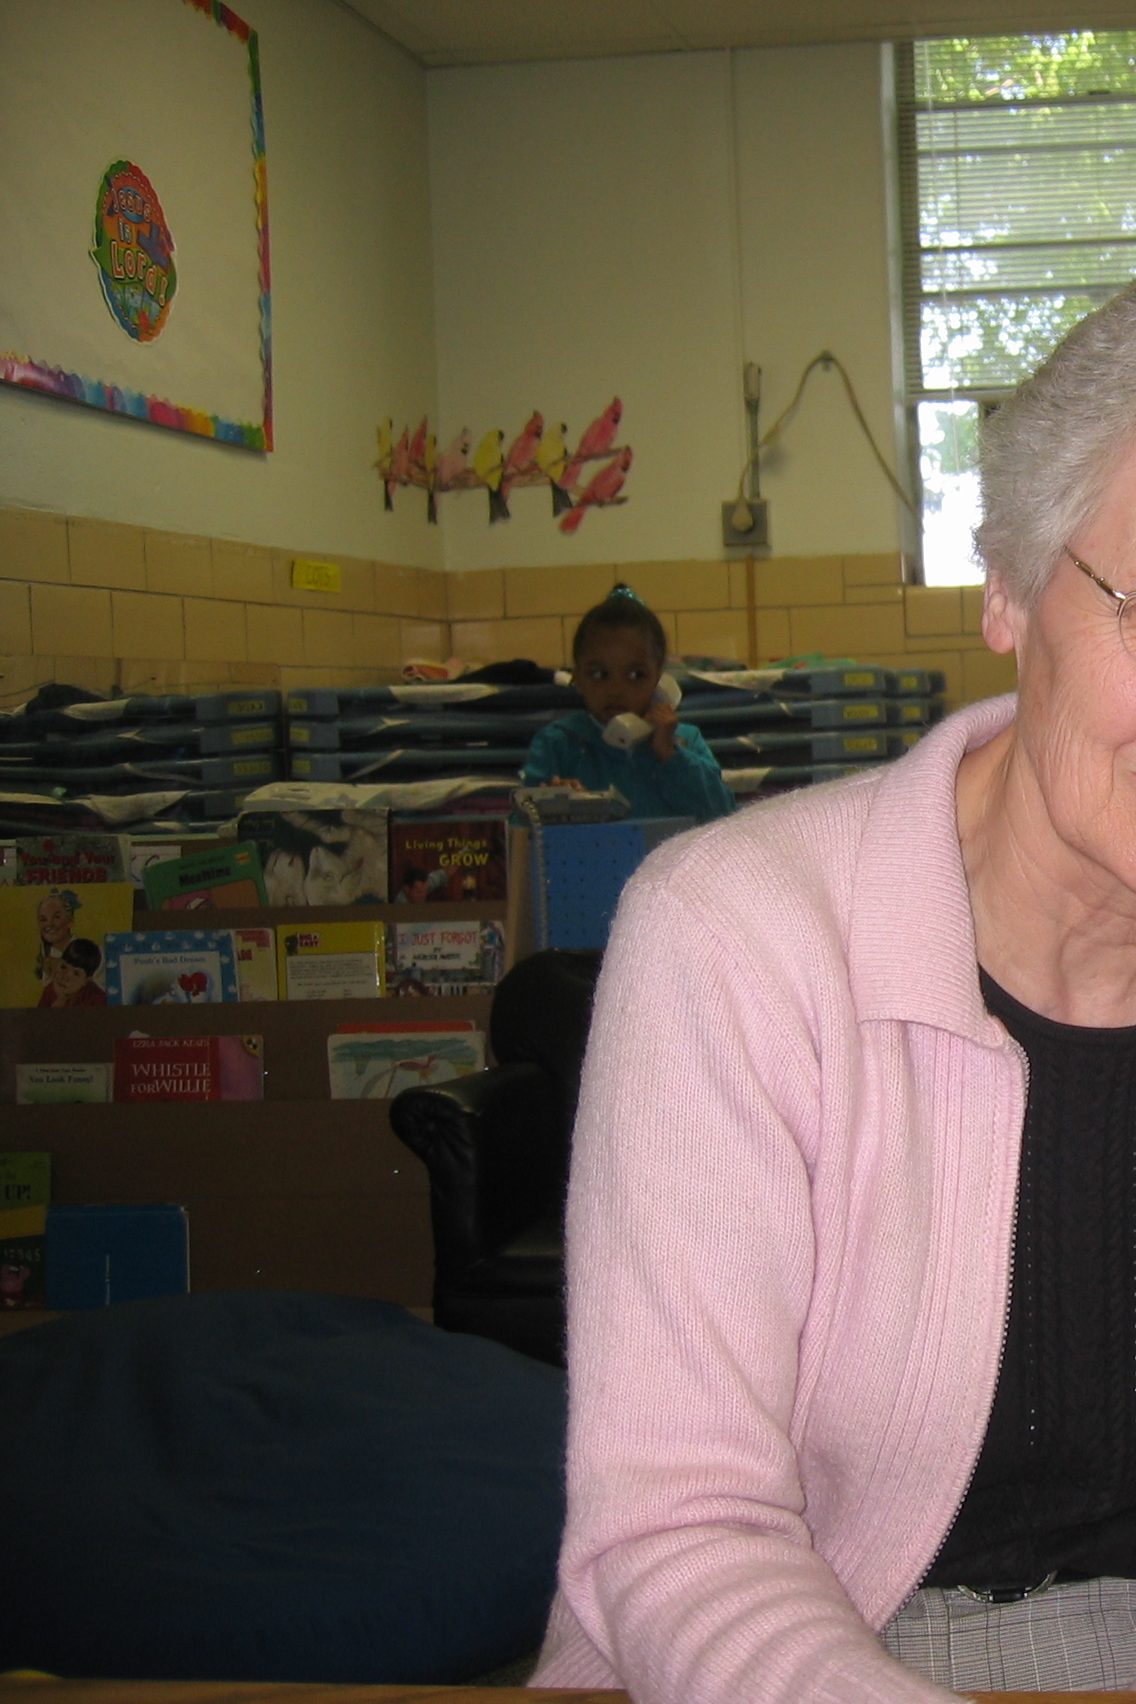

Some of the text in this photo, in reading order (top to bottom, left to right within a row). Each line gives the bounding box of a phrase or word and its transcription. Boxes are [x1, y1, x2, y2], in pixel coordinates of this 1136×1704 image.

[118, 217, 132, 244] is
[110, 240, 168, 307] Lord!
[405, 837, 488, 852] Living Things
[19, 850, 116, 866] You and Your
[439, 852, 489, 868] GROW
[26, 866, 108, 884] FRIENDS
[412, 932, 436, 946] JUST
[440, 931, 477, 945] FORGOT
[132, 1037, 210, 1048] EZRA JACK KEATS
[131, 1062, 211, 1078] WHISTLE
[131, 1078, 211, 1094] FOR WILLIE
